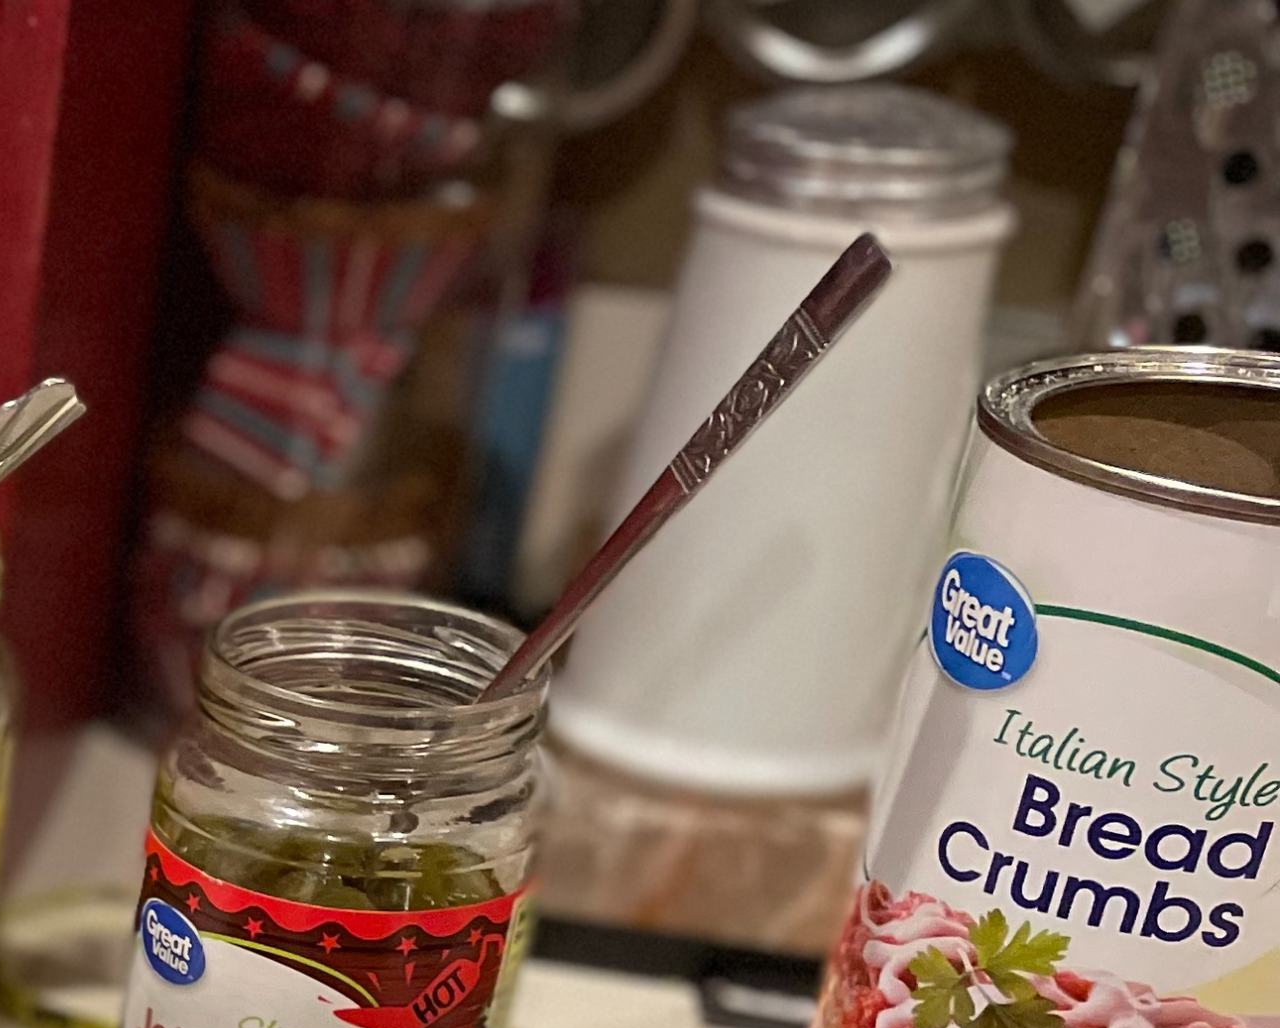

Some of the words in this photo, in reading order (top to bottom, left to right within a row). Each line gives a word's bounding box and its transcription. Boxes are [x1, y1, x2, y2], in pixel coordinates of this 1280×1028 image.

[942, 568, 1015, 648] Great
[946, 614, 1004, 673] Value
[993, 708, 1136, 787] Italian
[1153, 754, 1280, 821] Style
[1012, 774, 1274, 880] Bread
[938, 821, 1245, 948] Crumbs
[146, 908, 192, 961] Great
[153, 937, 189, 975] Value
[412, 969, 468, 1024] HOT
